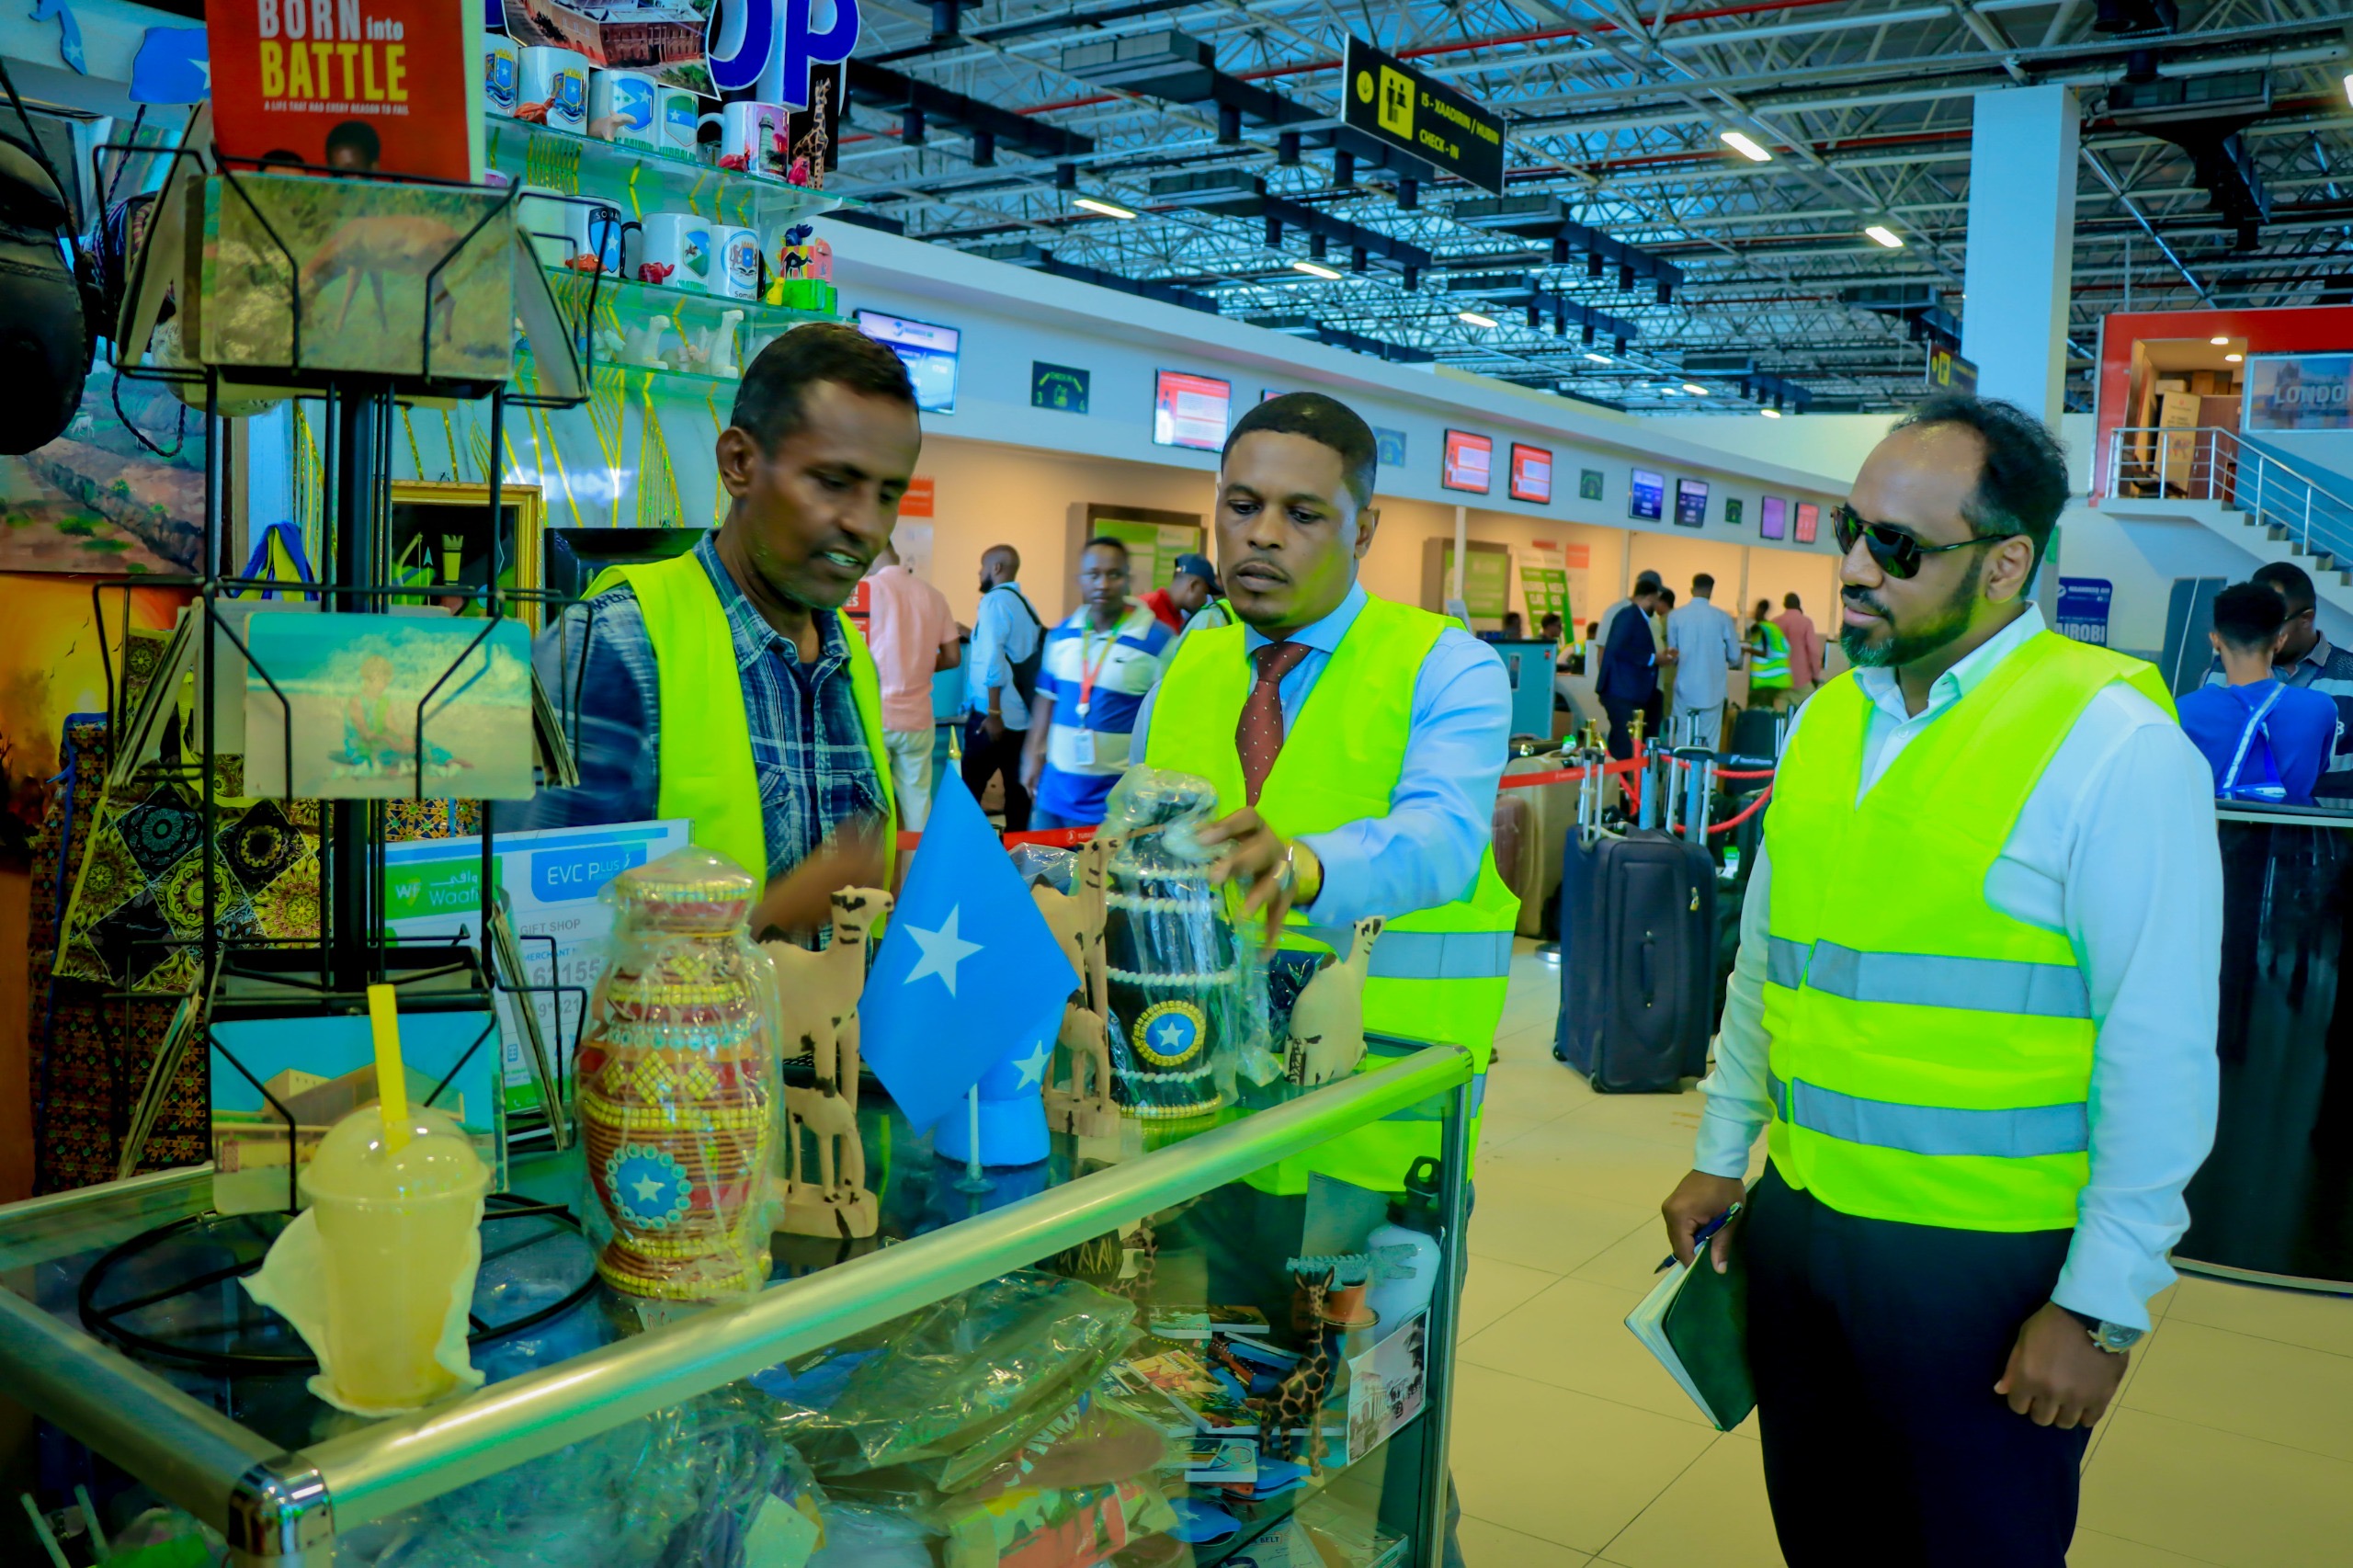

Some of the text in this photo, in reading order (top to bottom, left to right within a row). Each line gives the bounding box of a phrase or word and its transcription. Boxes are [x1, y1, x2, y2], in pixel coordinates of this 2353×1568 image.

[256, 0, 404, 40] BORN into
[259, 40, 409, 102] BATTLE
[547, 863, 584, 885] EVC
[519, 918, 582, 936] GIFT SHOP
